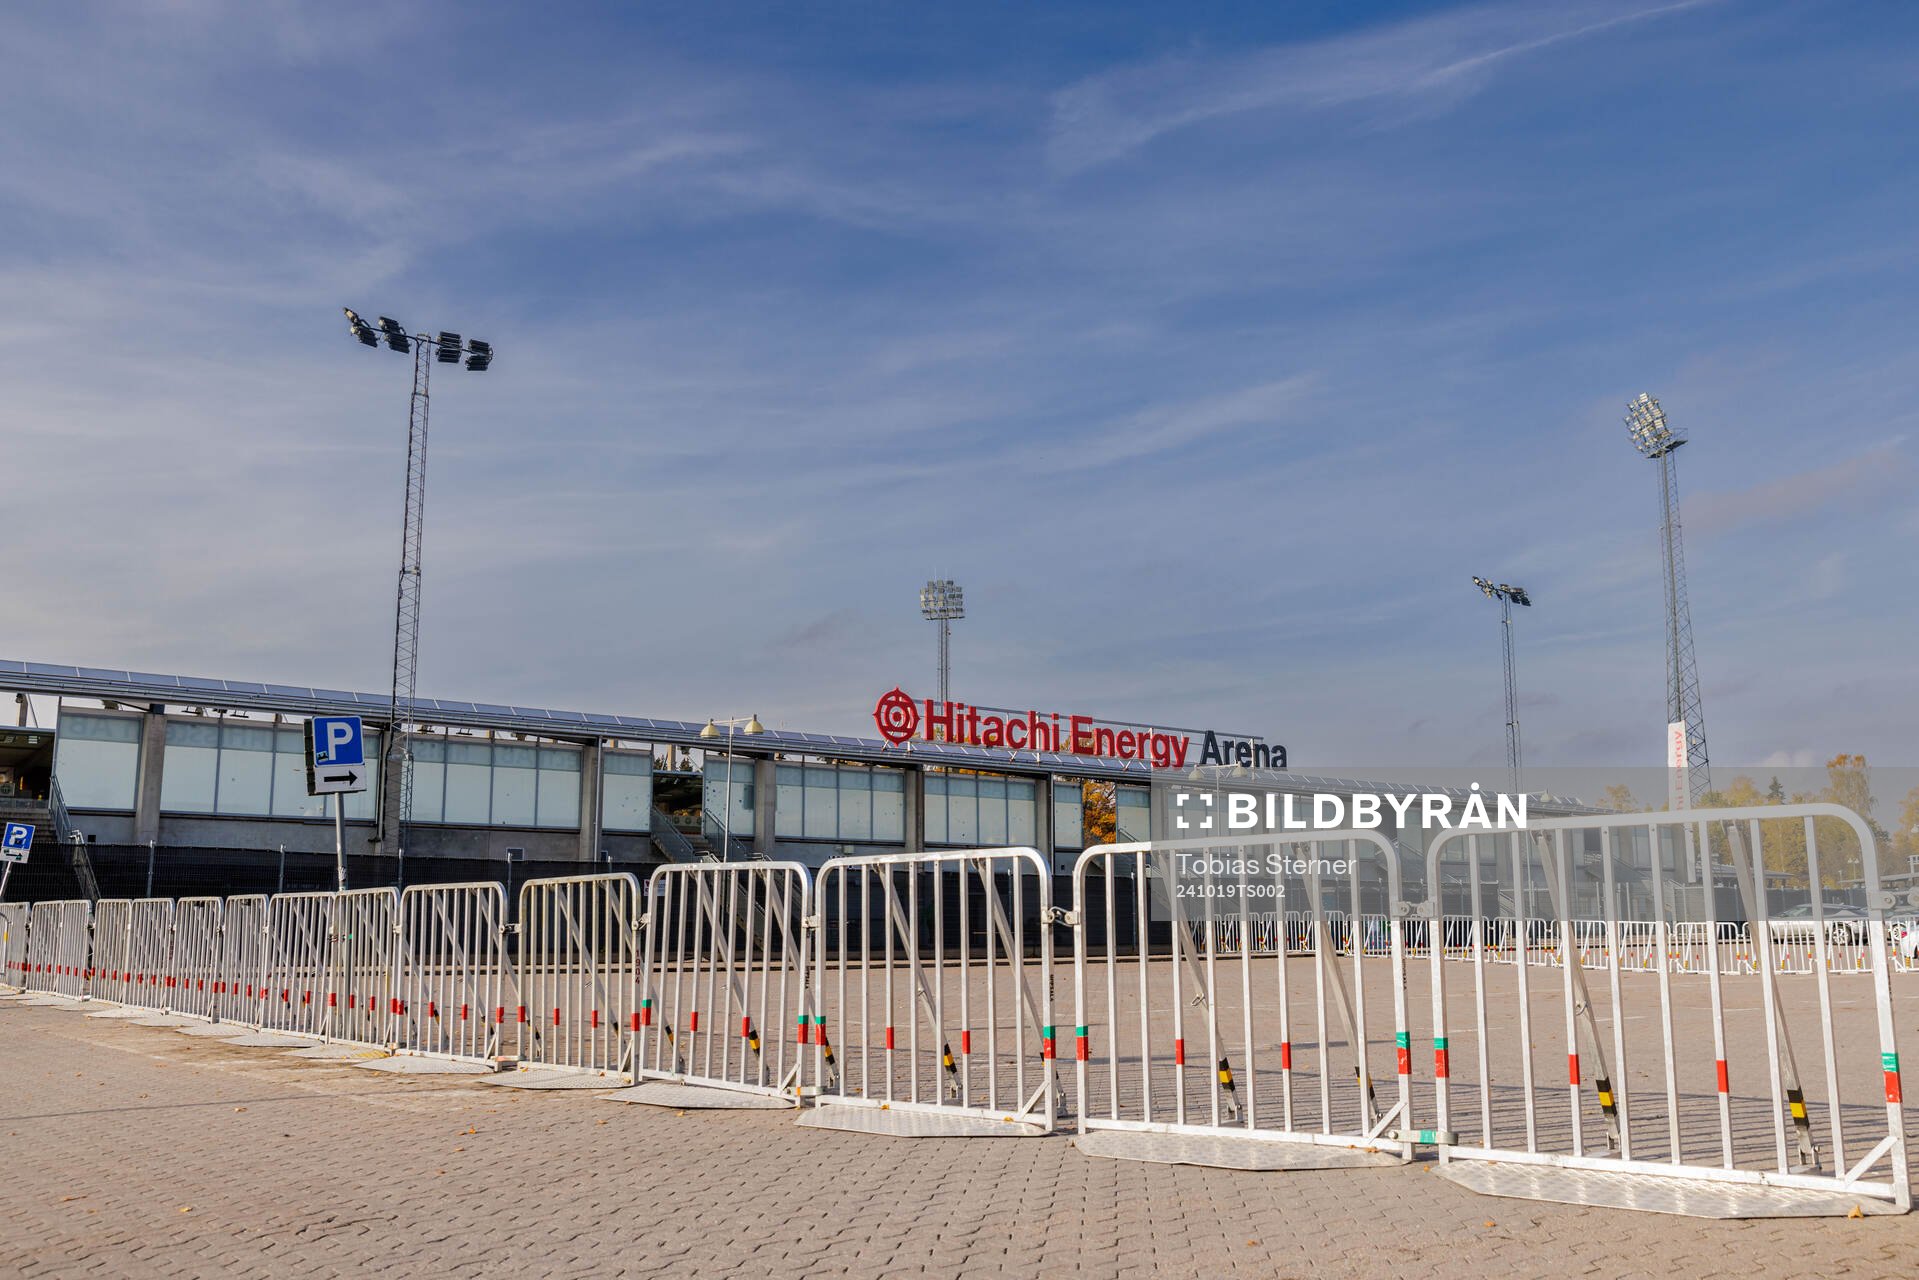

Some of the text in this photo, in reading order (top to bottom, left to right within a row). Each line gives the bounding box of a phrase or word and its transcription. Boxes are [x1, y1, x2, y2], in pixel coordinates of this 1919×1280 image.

[326, 722, 353, 761] P
[923, 699, 1288, 771] Hitachi Energy Arena
[9, 826, 28, 846] P
